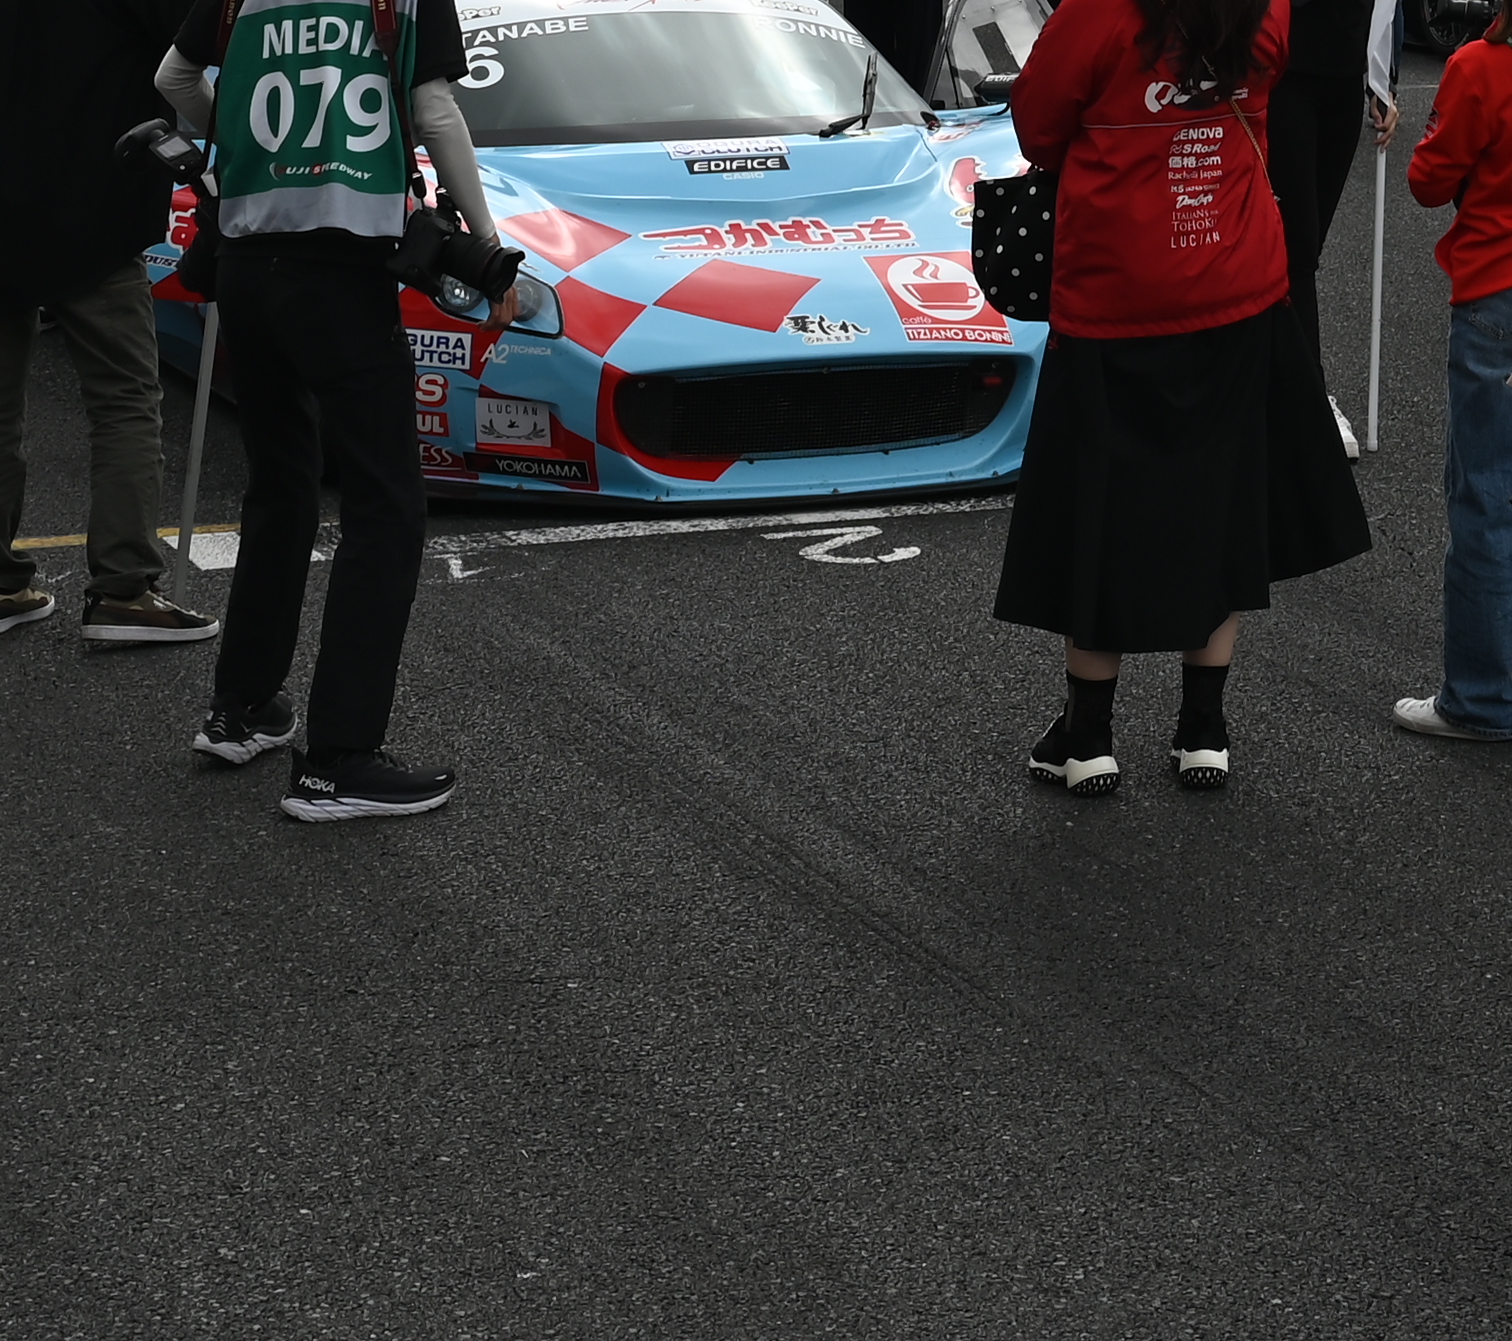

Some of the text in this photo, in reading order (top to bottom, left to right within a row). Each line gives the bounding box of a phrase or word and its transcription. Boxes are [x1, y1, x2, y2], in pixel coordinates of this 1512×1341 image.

[262, 16, 389, 61] MEDIA
[752, 15, 867, 49] RONNIE
[458, 46, 505, 89] 6
[250, 66, 390, 153] 079
[693, 158, 781, 172] EDIFICE
[408, 333, 466, 351] GURA
[907, 327, 963, 341] TIZIANO
[414, 350, 466, 366] UTCH
[480, 343, 551, 364] A2 TECHNICA
[488, 403, 538, 416] LUCIAN
[496, 458, 582, 478] YOKOHAMA
